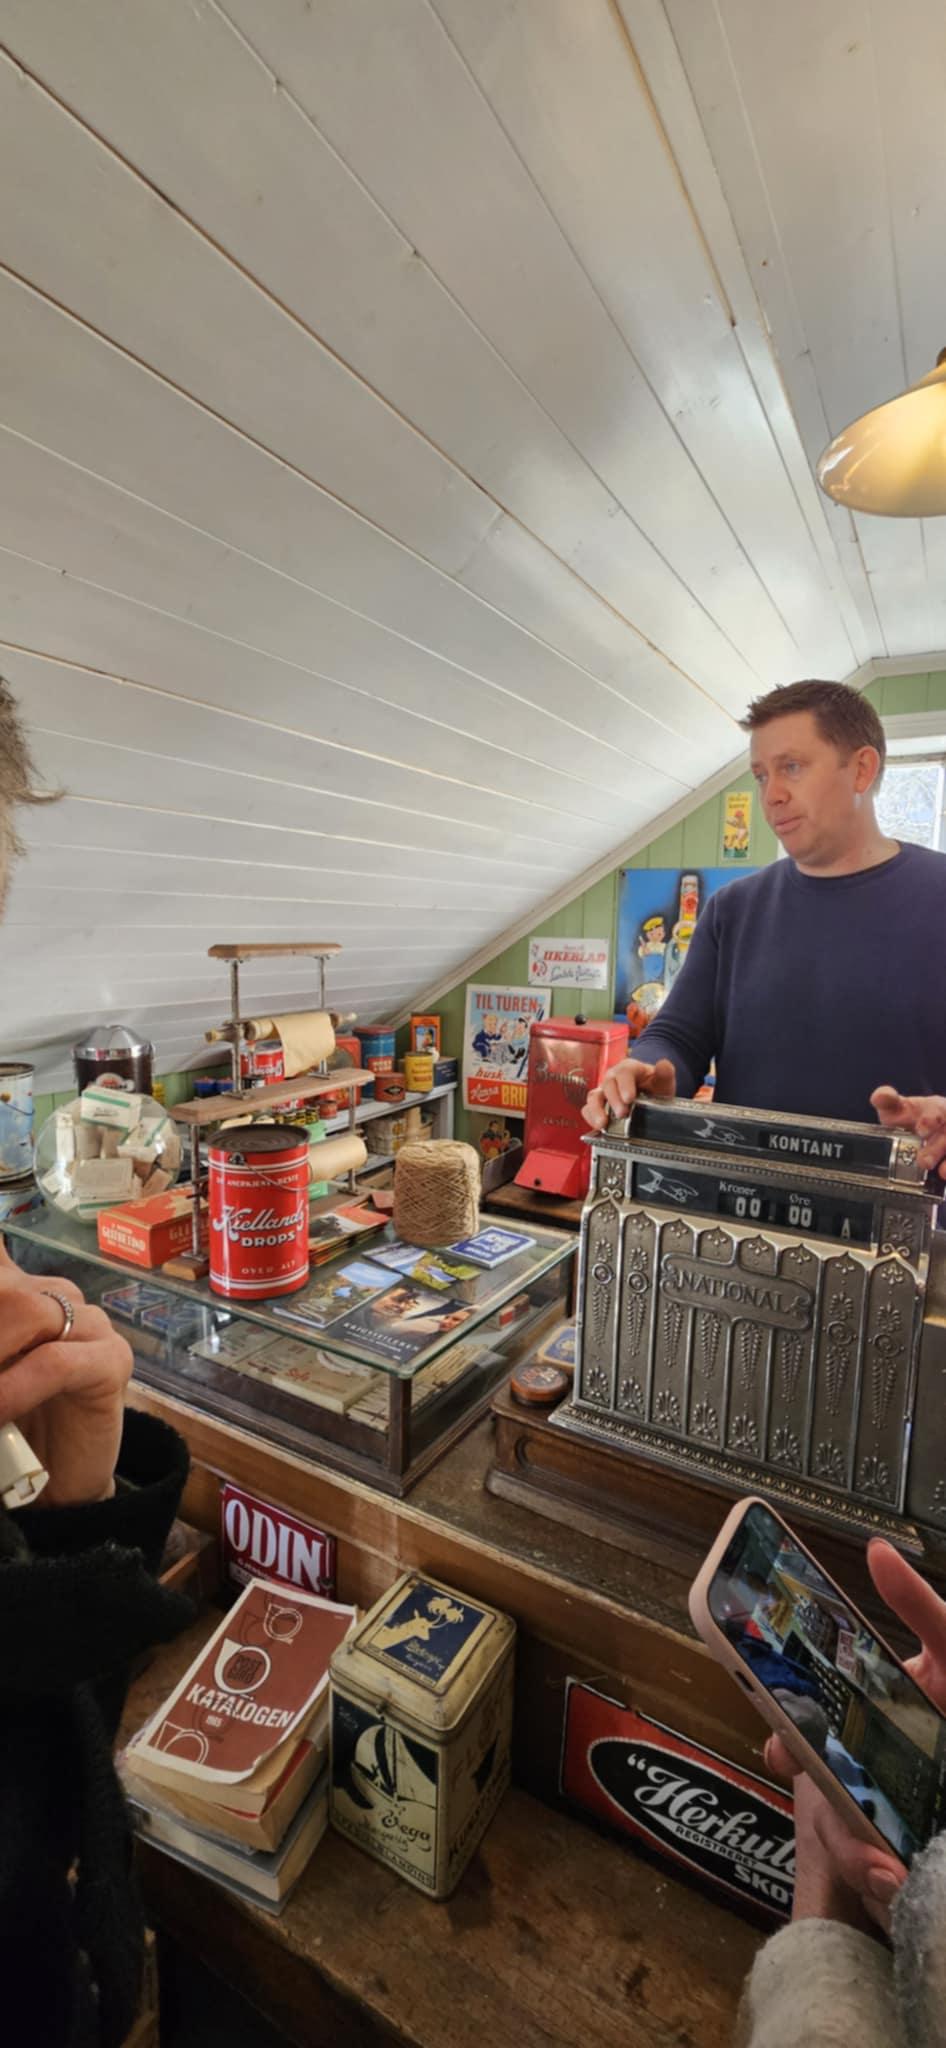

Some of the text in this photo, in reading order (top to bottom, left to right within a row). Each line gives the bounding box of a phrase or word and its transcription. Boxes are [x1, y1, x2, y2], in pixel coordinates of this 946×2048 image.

[476, 993, 494, 1010] TIL
[501, 1084, 528, 1106] BRU
[768, 1134, 844, 1158] KONTANT
[719, 1181, 757, 1195] Kroner
[735, 1196, 851, 1240] 00 00 A
[241, 1230, 296, 1248] DROPS
[673, 1268, 790, 1313] NATIONAL
[225, 1499, 324, 1592] ODIN
[186, 1683, 295, 1729] KATALOGEN
[675, 1826, 756, 1867] REGISTRERET
[734, 1864, 794, 1904] SKO
